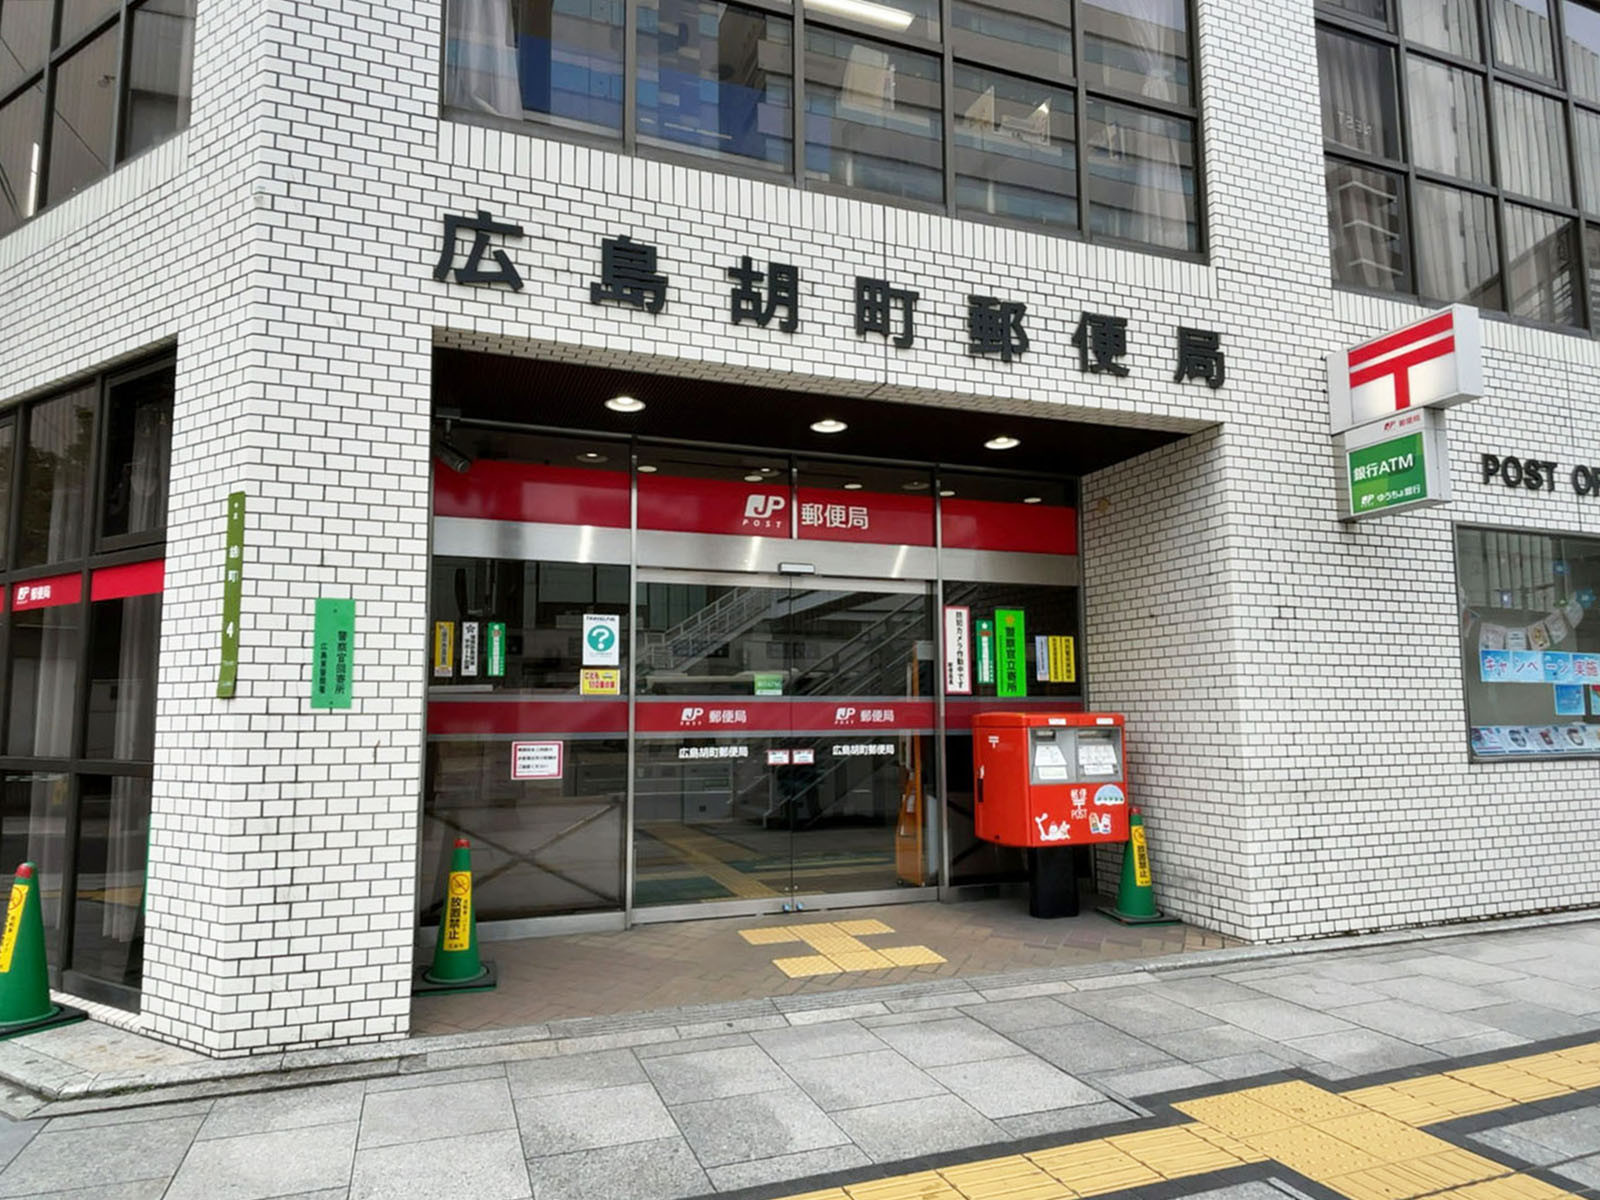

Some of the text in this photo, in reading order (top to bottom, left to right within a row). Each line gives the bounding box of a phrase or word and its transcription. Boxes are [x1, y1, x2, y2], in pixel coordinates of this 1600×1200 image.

[433, 210, 1225, 390] 広島胡町郵便局
[1353, 453, 1414, 482] 銀行ATM
[1481, 453, 1558, 493] POST
[742, 519, 782, 529] POST
[801, 503, 869, 530] 郵便局
[708, 709, 747, 724] 郵便局
[860, 709, 895, 722] 郵便局
[678, 746, 749, 759] 広島胡町郵便局
[832, 744, 895, 756] 広島胡町郵便局
